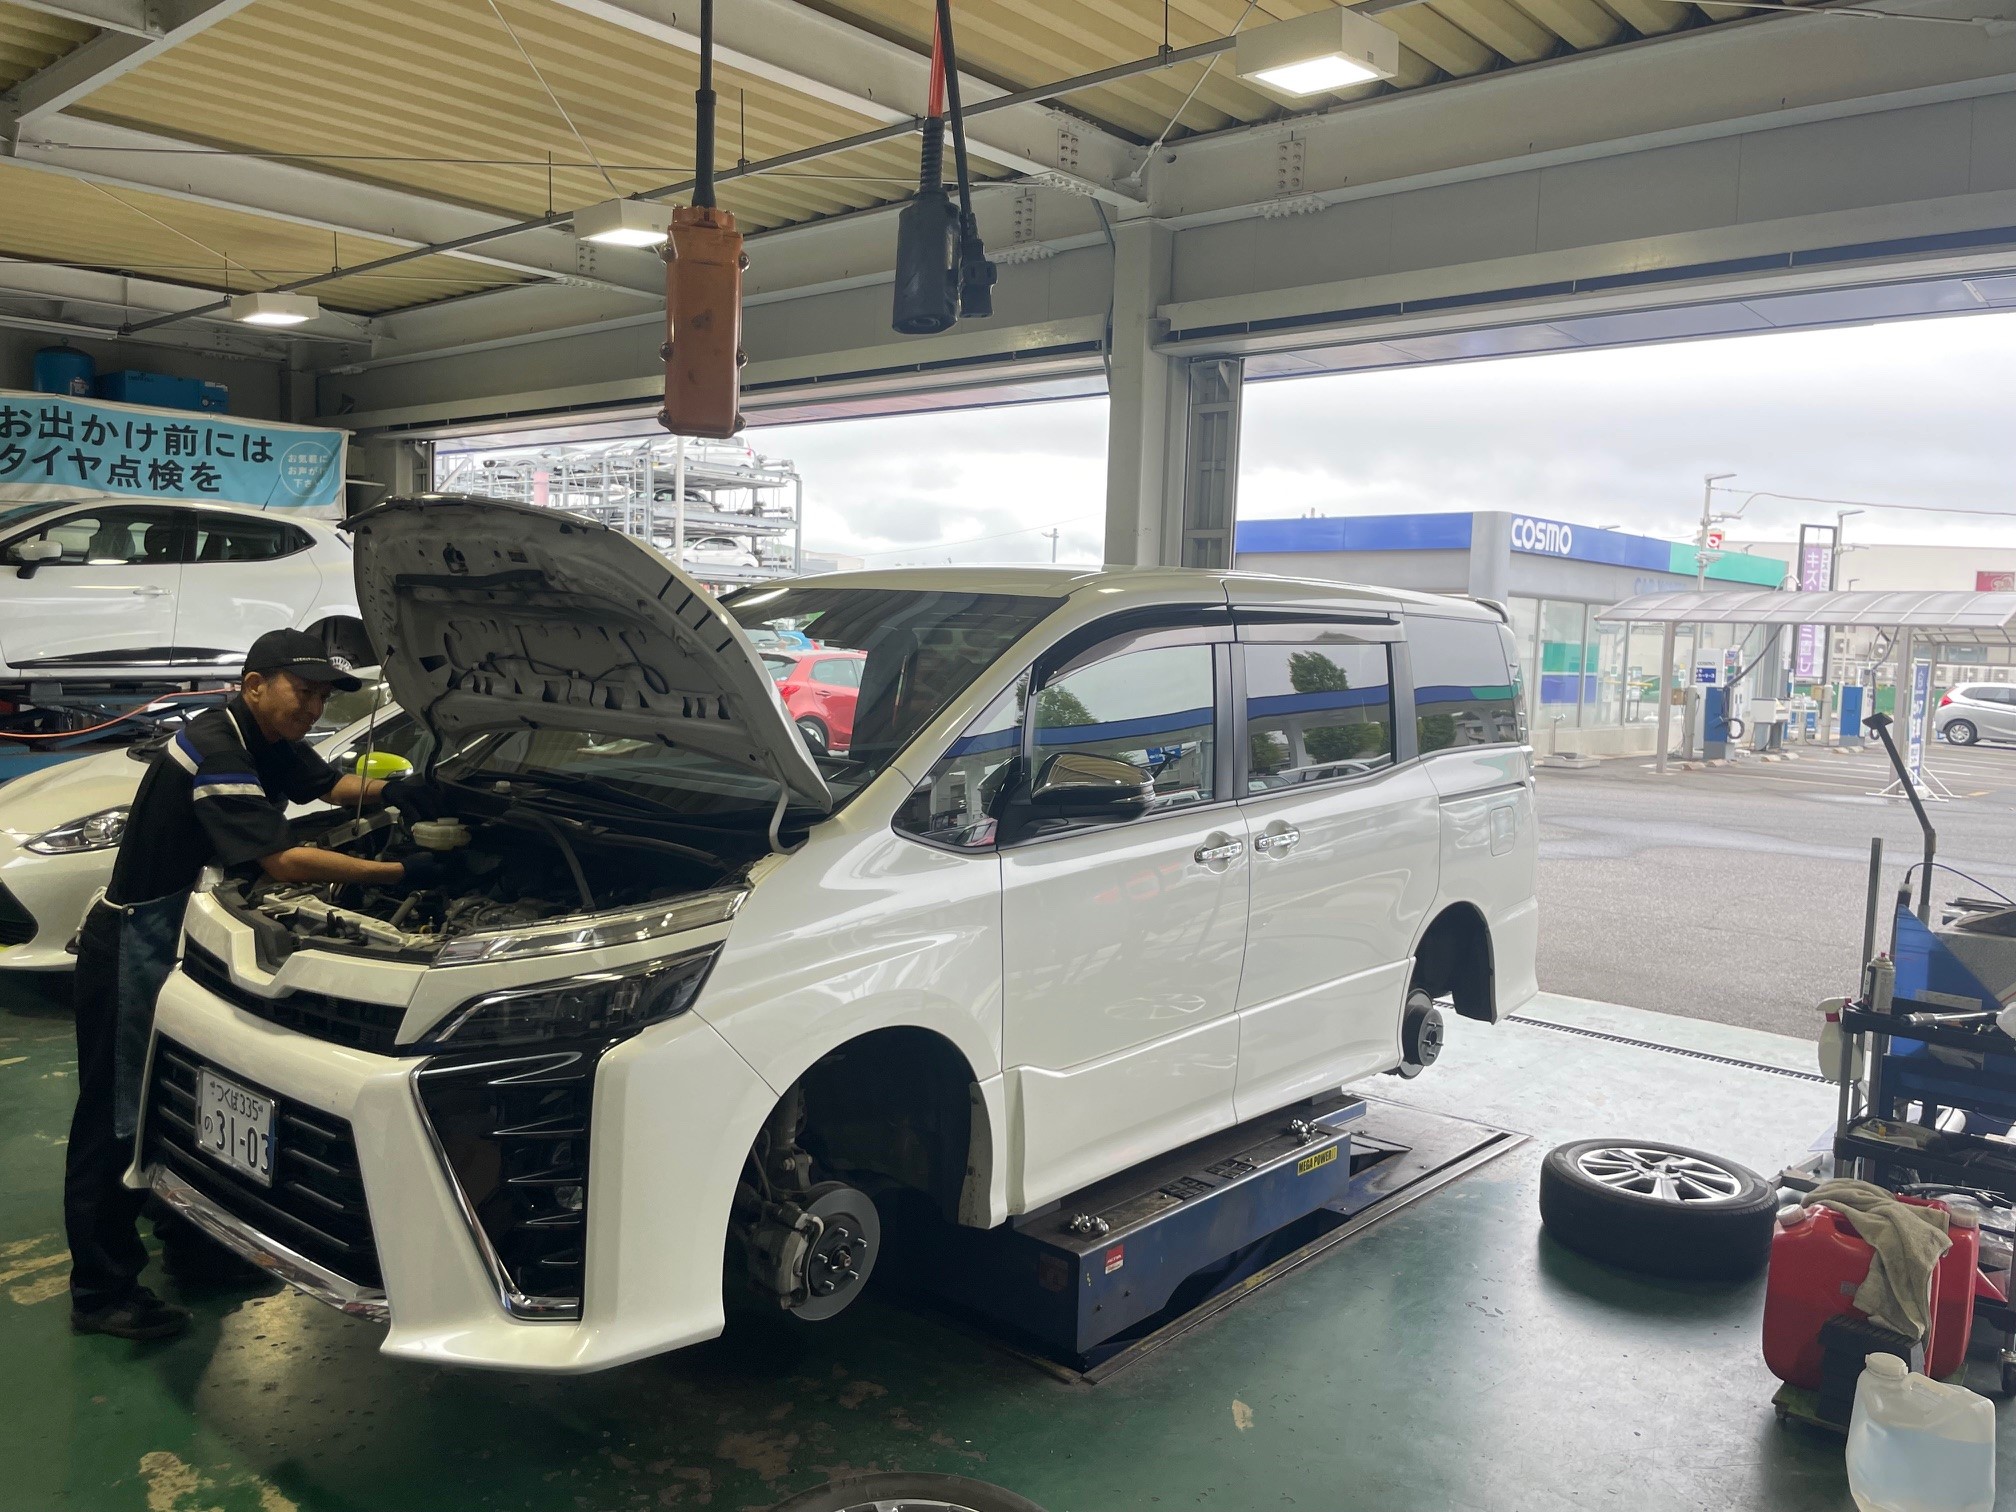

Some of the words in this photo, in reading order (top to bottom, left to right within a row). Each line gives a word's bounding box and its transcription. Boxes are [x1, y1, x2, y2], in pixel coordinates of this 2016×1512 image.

[0, 405, 274, 464] お出かけ前には
[0, 442, 222, 493] タイヤ点検を
[1511, 518, 1572, 555] COSMO
[217, 1084, 238, 1111] つくば
[239, 1094, 259, 1121] 335
[204, 1115, 214, 1134] の
[216, 1109, 269, 1175] 31-03
[1299, 1158, 1313, 1174] MEGA
[1314, 1150, 1331, 1167] POWER
